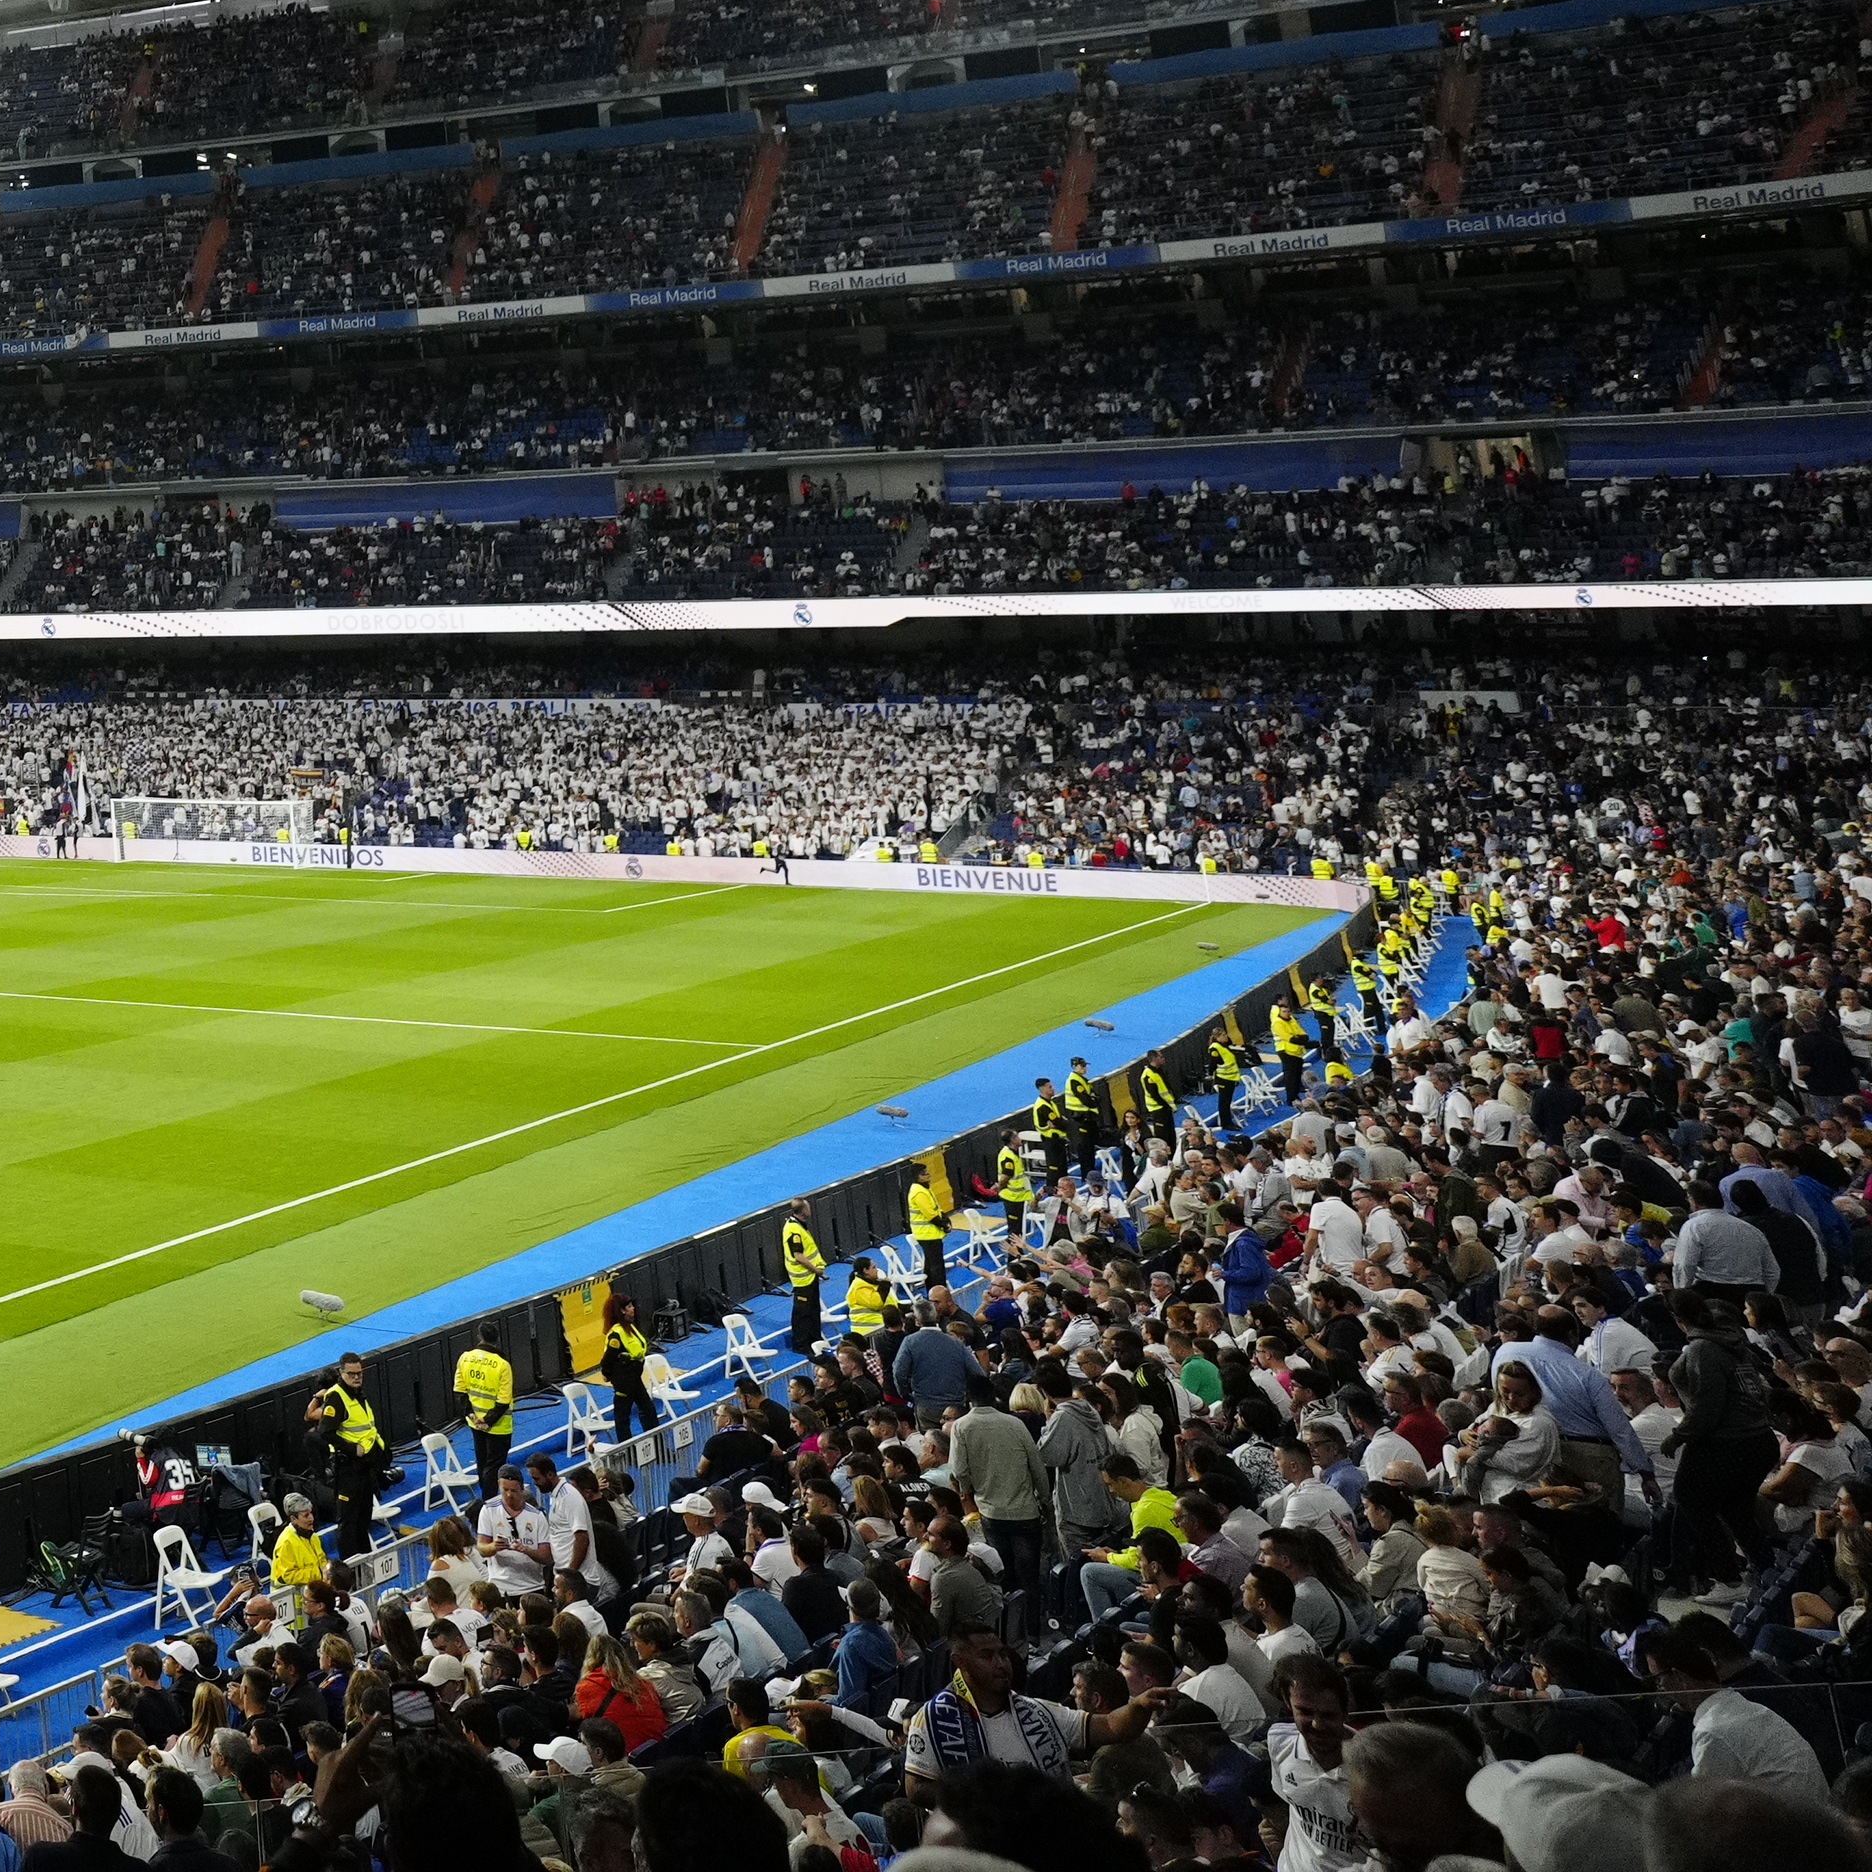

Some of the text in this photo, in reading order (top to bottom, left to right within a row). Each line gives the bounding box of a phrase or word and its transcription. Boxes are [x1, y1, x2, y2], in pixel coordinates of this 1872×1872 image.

[1694, 183, 1825, 212] Real Madrid
[1446, 210, 1566, 234] Real Madrid
[1213, 234, 1330, 257] Real Madrid
[1006, 252, 1108, 274] Real Madrid
[809, 273, 907, 293] Real Madrid
[630, 287, 717, 307] Real Madrid
[457, 305, 544, 322] Real Madrid
[299, 317, 377, 333] Real Madrid
[2, 340, 29, 354] Real
[145, 330, 222, 346] Real Madrid
[1170, 595, 1263, 609] WELCOME
[252, 846, 384, 866] BIENVENIDOS
[917, 868, 1057, 892] BIENVENUE
[1500, 1121, 1511, 1141] 7
[469, 1371, 486, 1381] 080
[165, 1458, 195, 1490] 35
[899, 1483, 931, 1493] ALONSO
[380, 1557, 393, 1575] 107
[1316, 1828, 1353, 1853] BETTER
